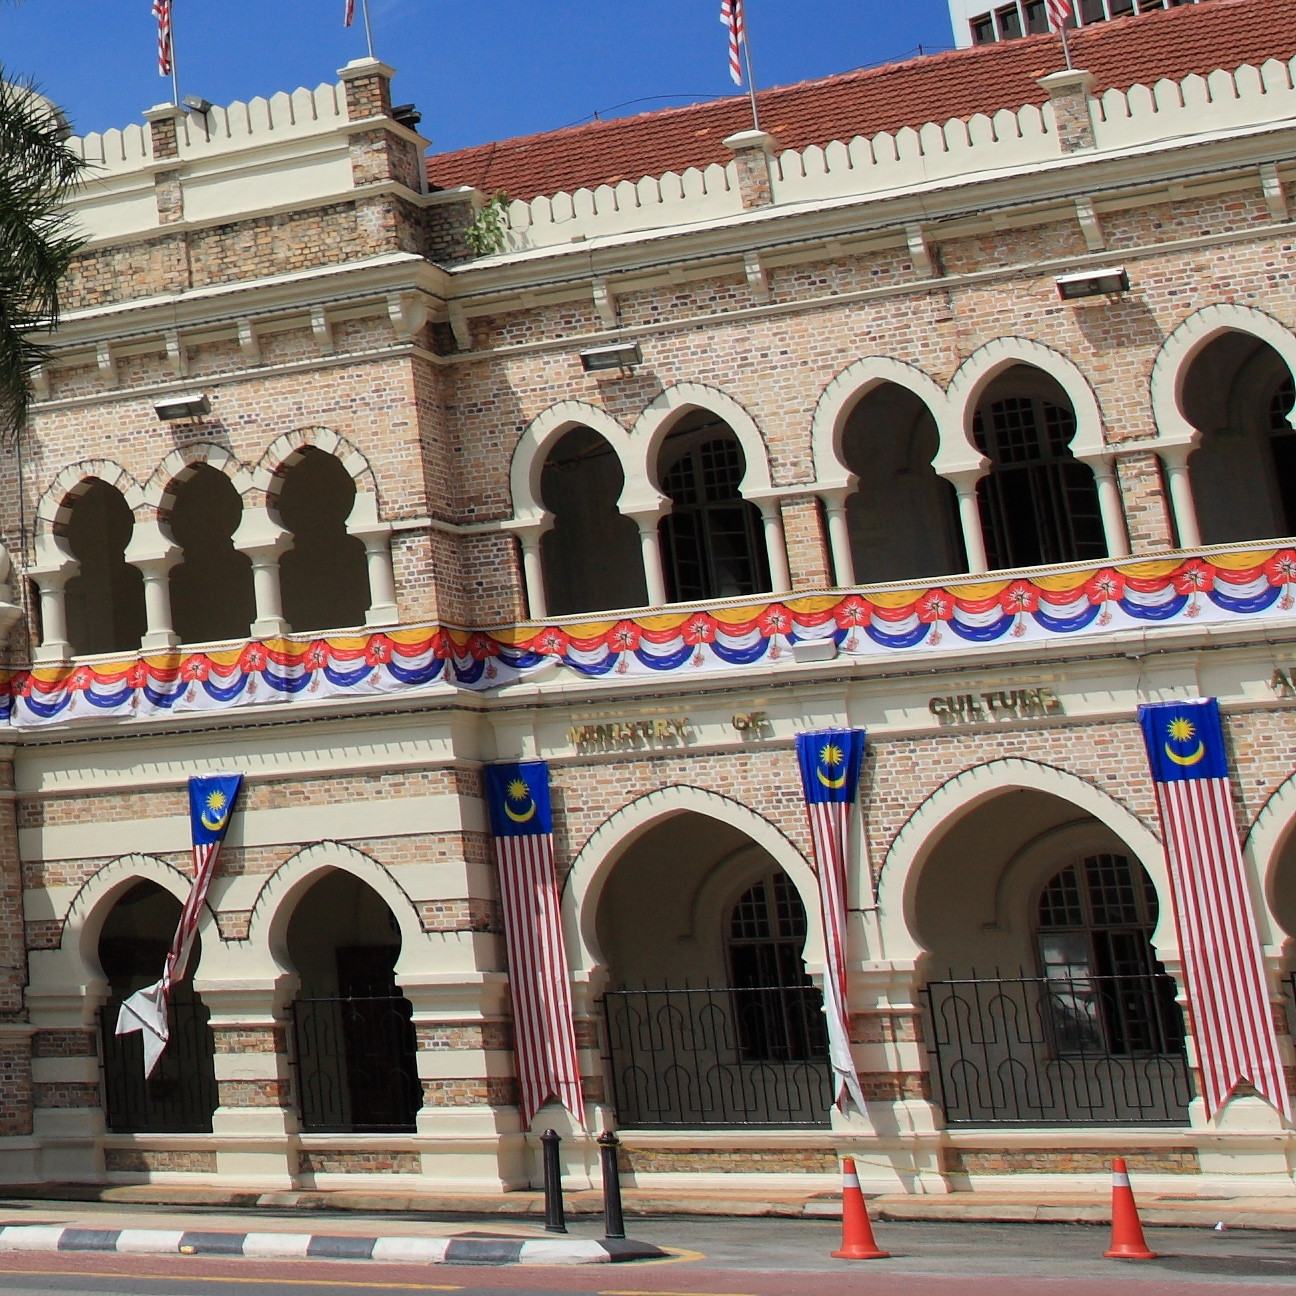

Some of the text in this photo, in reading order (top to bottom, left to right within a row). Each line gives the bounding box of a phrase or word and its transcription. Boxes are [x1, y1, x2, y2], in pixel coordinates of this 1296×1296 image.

[567, 687, 1062, 745] MINISTRY OF CULTURE
